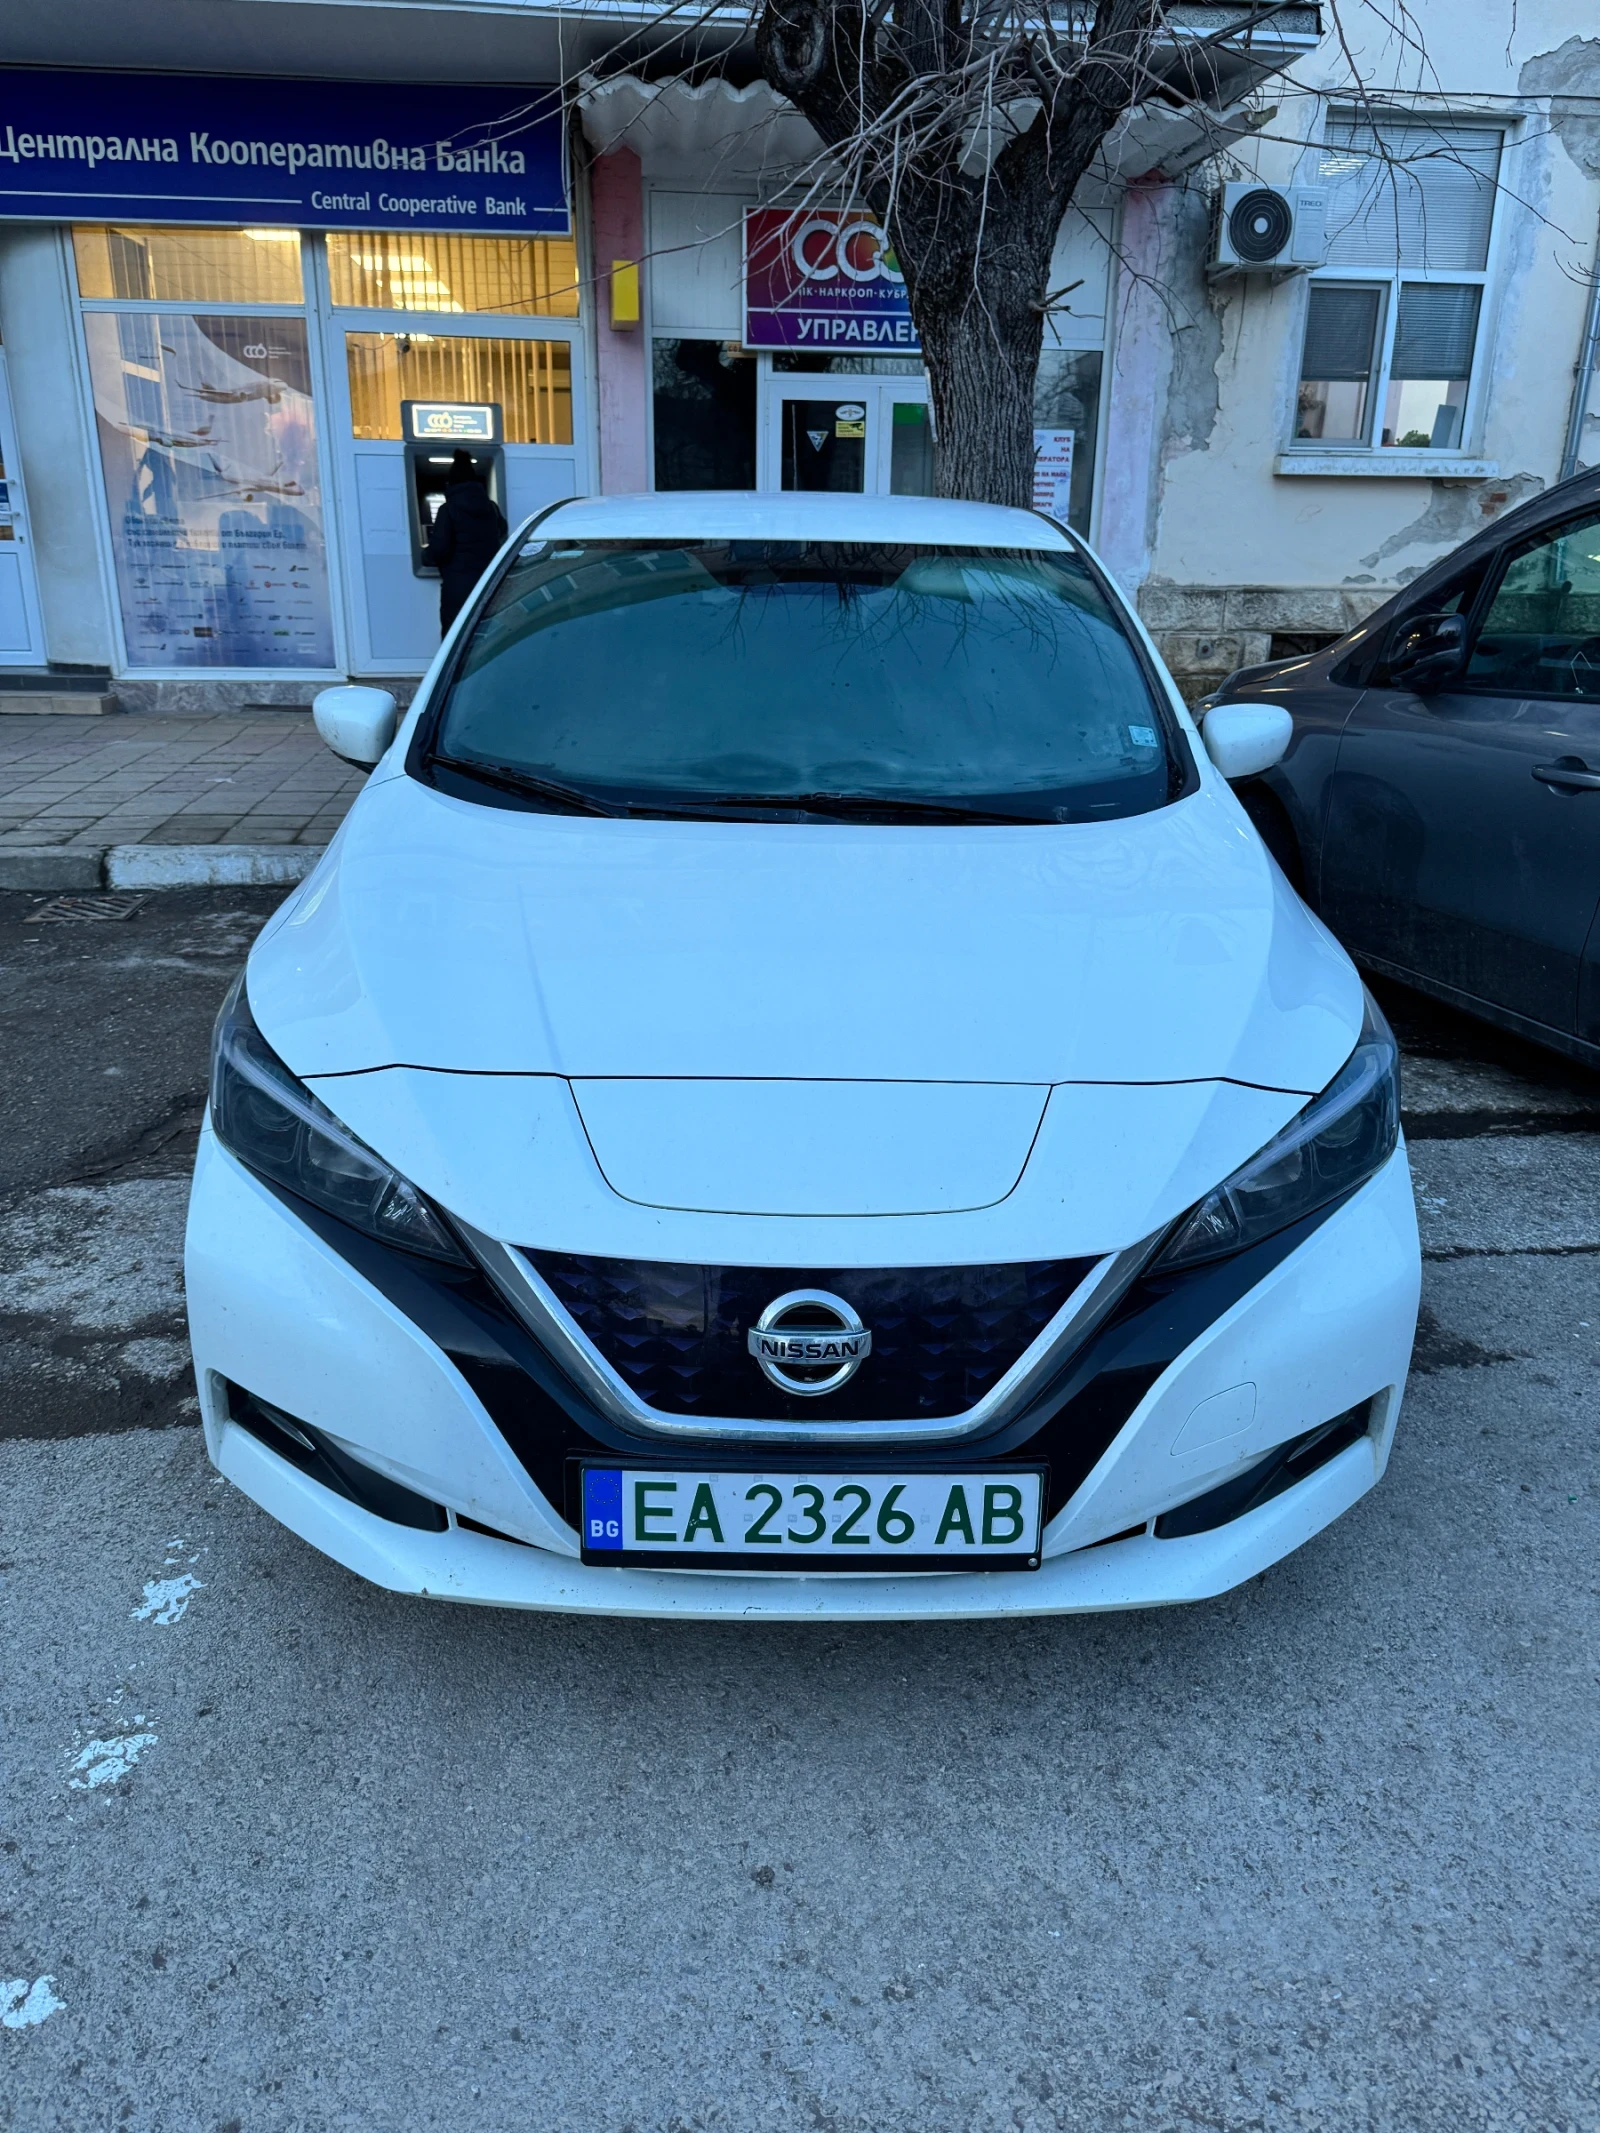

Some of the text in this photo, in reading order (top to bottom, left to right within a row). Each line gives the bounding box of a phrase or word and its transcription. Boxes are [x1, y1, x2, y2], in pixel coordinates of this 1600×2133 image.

[0, 126, 526, 175] Централна Кооперативна Банка
[311, 190, 527, 217] Central Cooperative Bank
[761, 1339, 859, 1358] NISSAN
[591, 1481, 1024, 1545] BG EA 2326 AB
